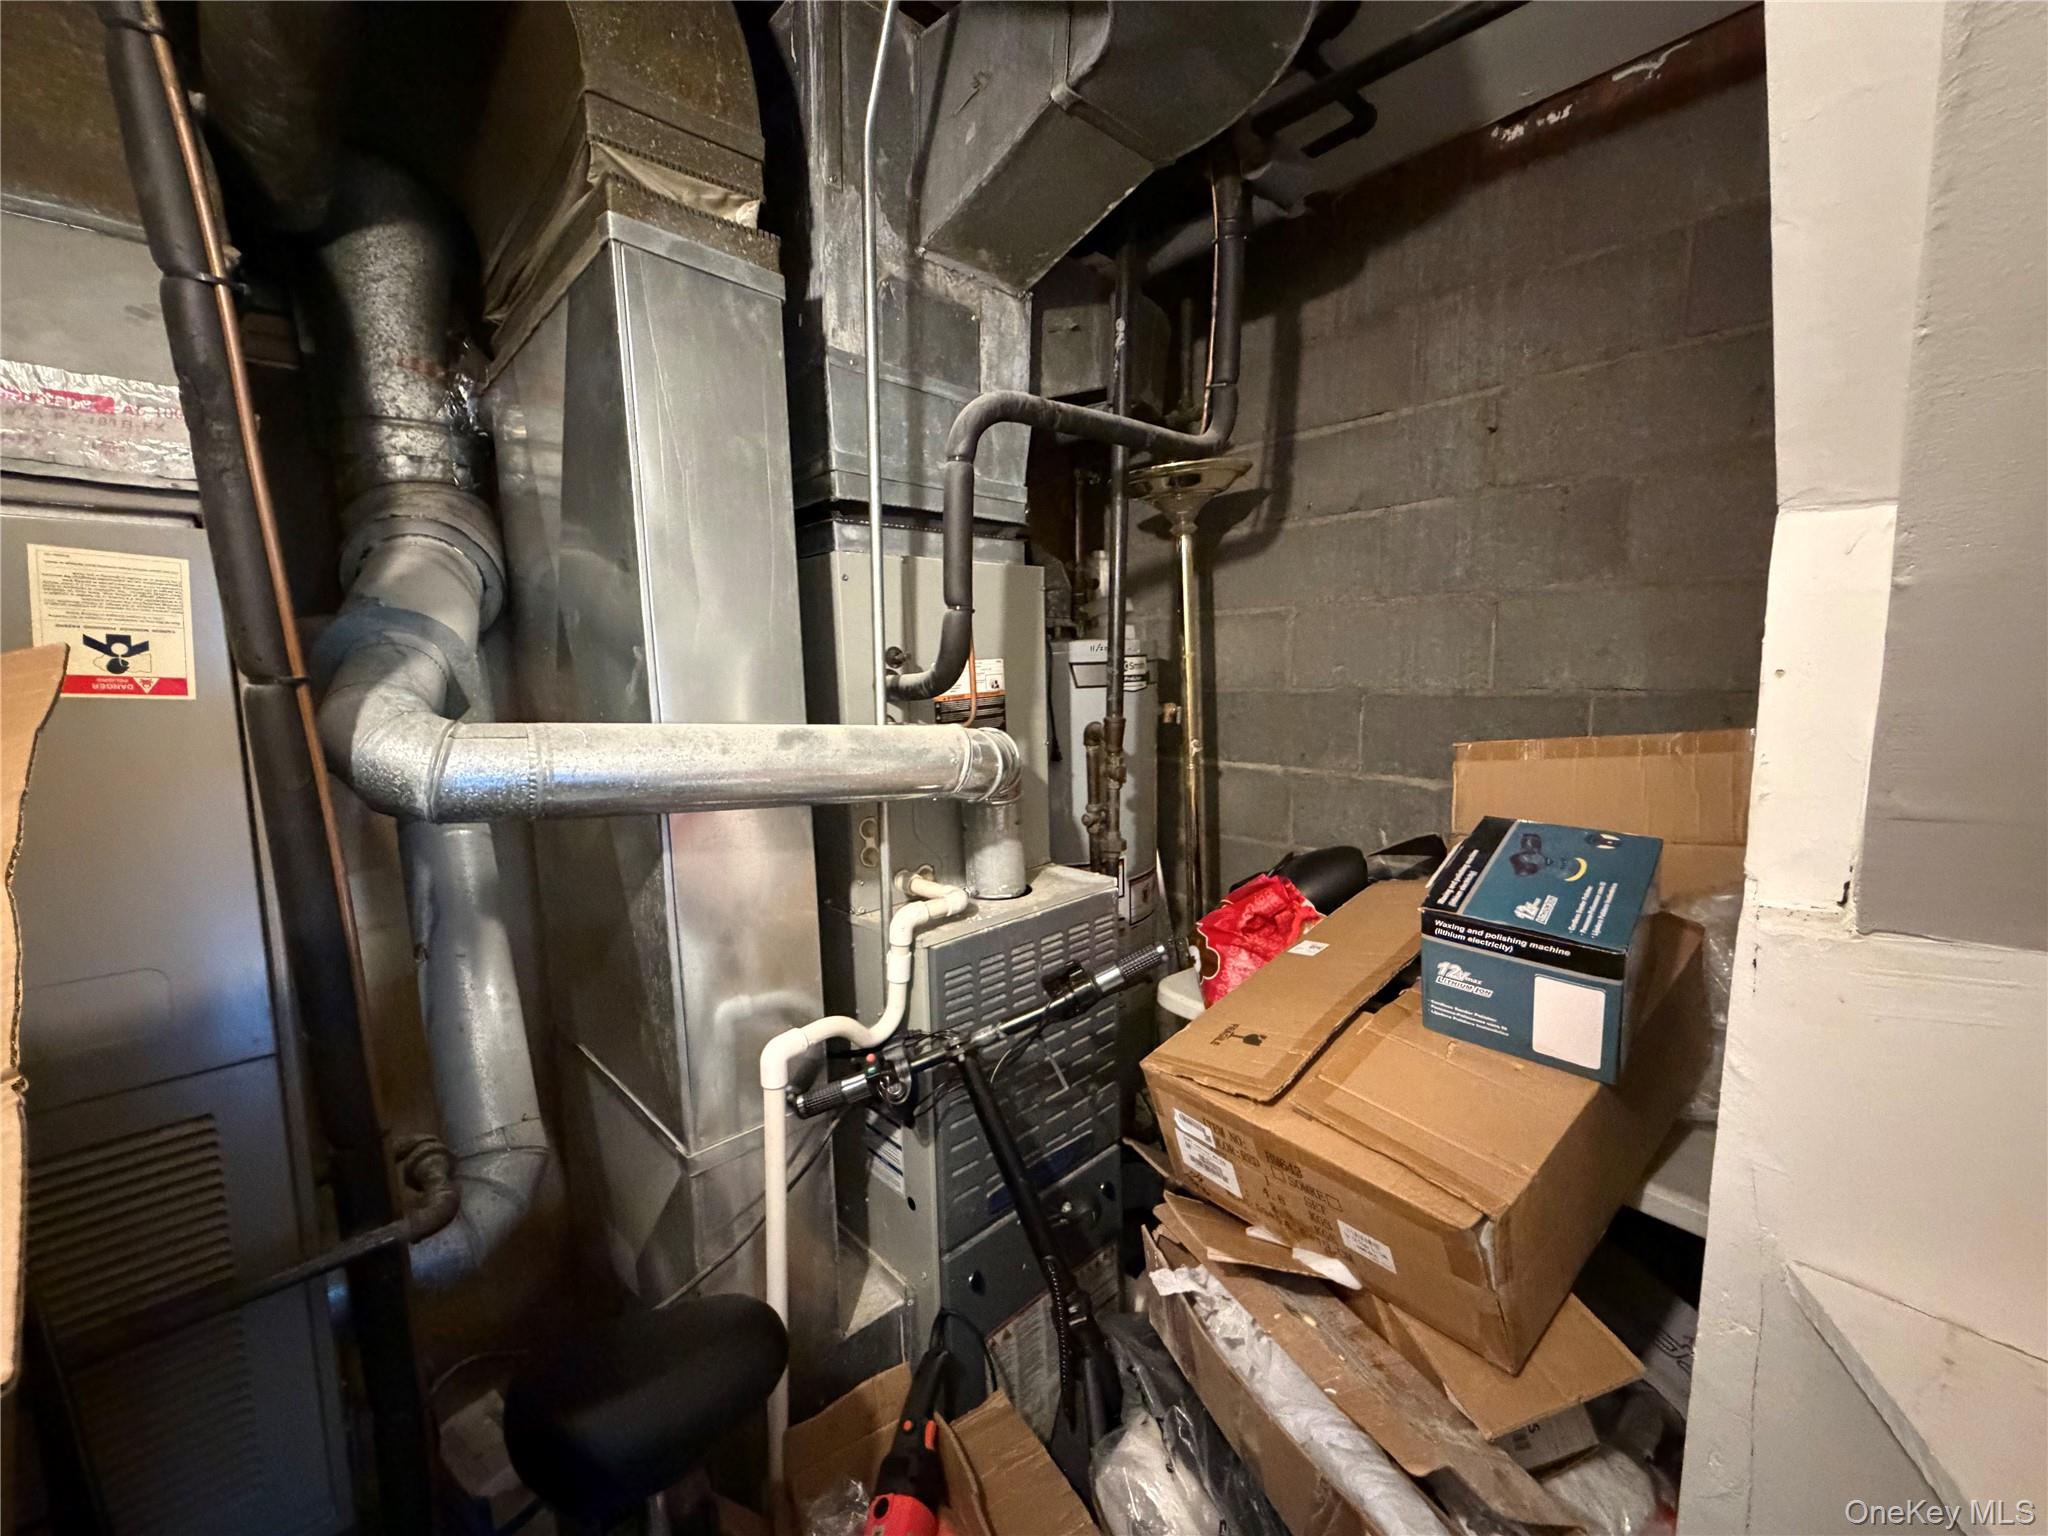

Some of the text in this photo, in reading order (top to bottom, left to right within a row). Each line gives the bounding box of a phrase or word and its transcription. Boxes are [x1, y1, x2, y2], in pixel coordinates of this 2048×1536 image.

[1434, 919, 1572, 956] Waxing and polishing machine
[1434, 928, 1514, 954] (lithium electricity)
